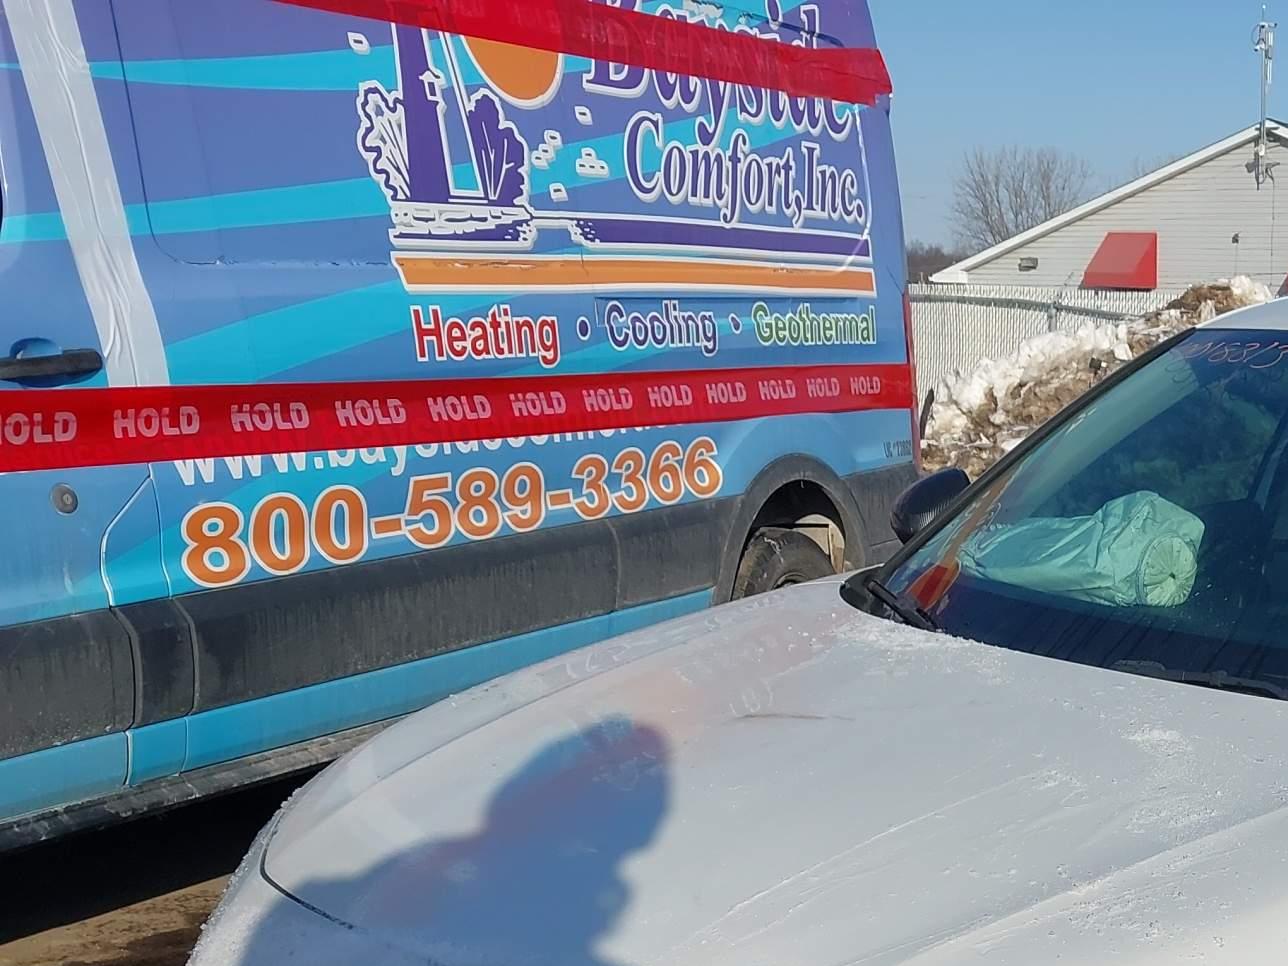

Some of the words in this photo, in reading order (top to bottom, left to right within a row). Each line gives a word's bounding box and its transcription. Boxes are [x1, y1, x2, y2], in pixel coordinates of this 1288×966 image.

[625, 114, 802, 226] Comfort,
[803, 143, 865, 220] Inc.
[411, 305, 559, 366] Heating
[605, 300, 717, 356] Cooling
[752, 301, 877, 346] Geothermal
[0, 411, 78, 446] OLD
[113, 406, 200, 439] HOLD
[231, 401, 310, 432] HOLD
[336, 398, 407, 427] HOLD
[427, 394, 492, 421] HOLD
[510, 390, 566, 416] HOLD
[583, 387, 632, 411] HOLD
[648, 384, 693, 408] HOLD
[706, 381, 747, 403] HOLD
[757, 379, 796, 400] HOLD
[806, 377, 840, 397] HOLD
[850, 376, 881, 395] HOLD
[182, 436, 722, 587] 800-589-3366
